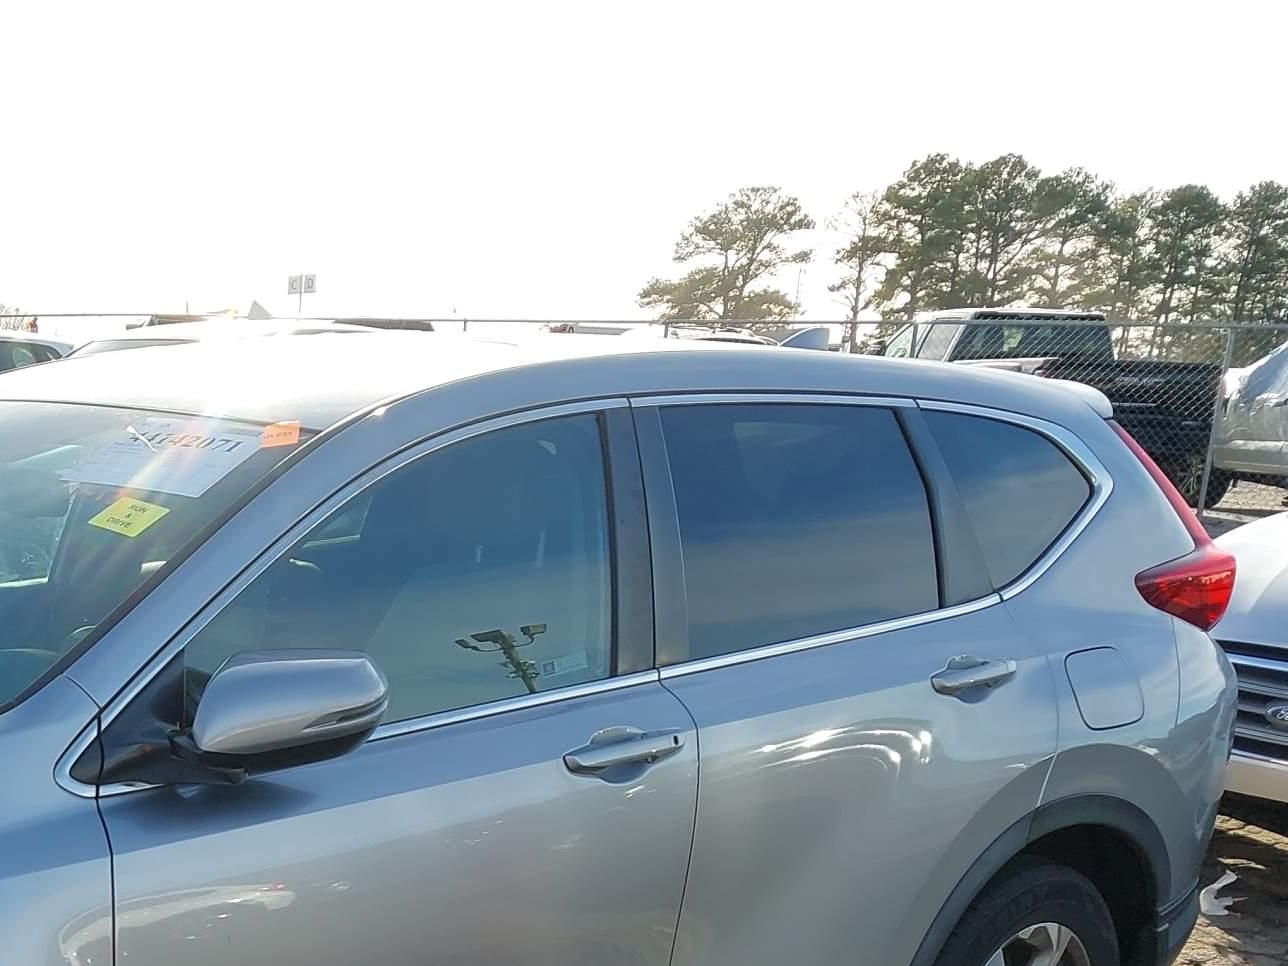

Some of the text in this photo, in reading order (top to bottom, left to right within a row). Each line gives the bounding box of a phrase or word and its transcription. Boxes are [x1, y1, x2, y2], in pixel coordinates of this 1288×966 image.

[307, 278, 314, 289] D
[128, 503, 149, 515] RUN
[105, 516, 133, 529] DRIVE
